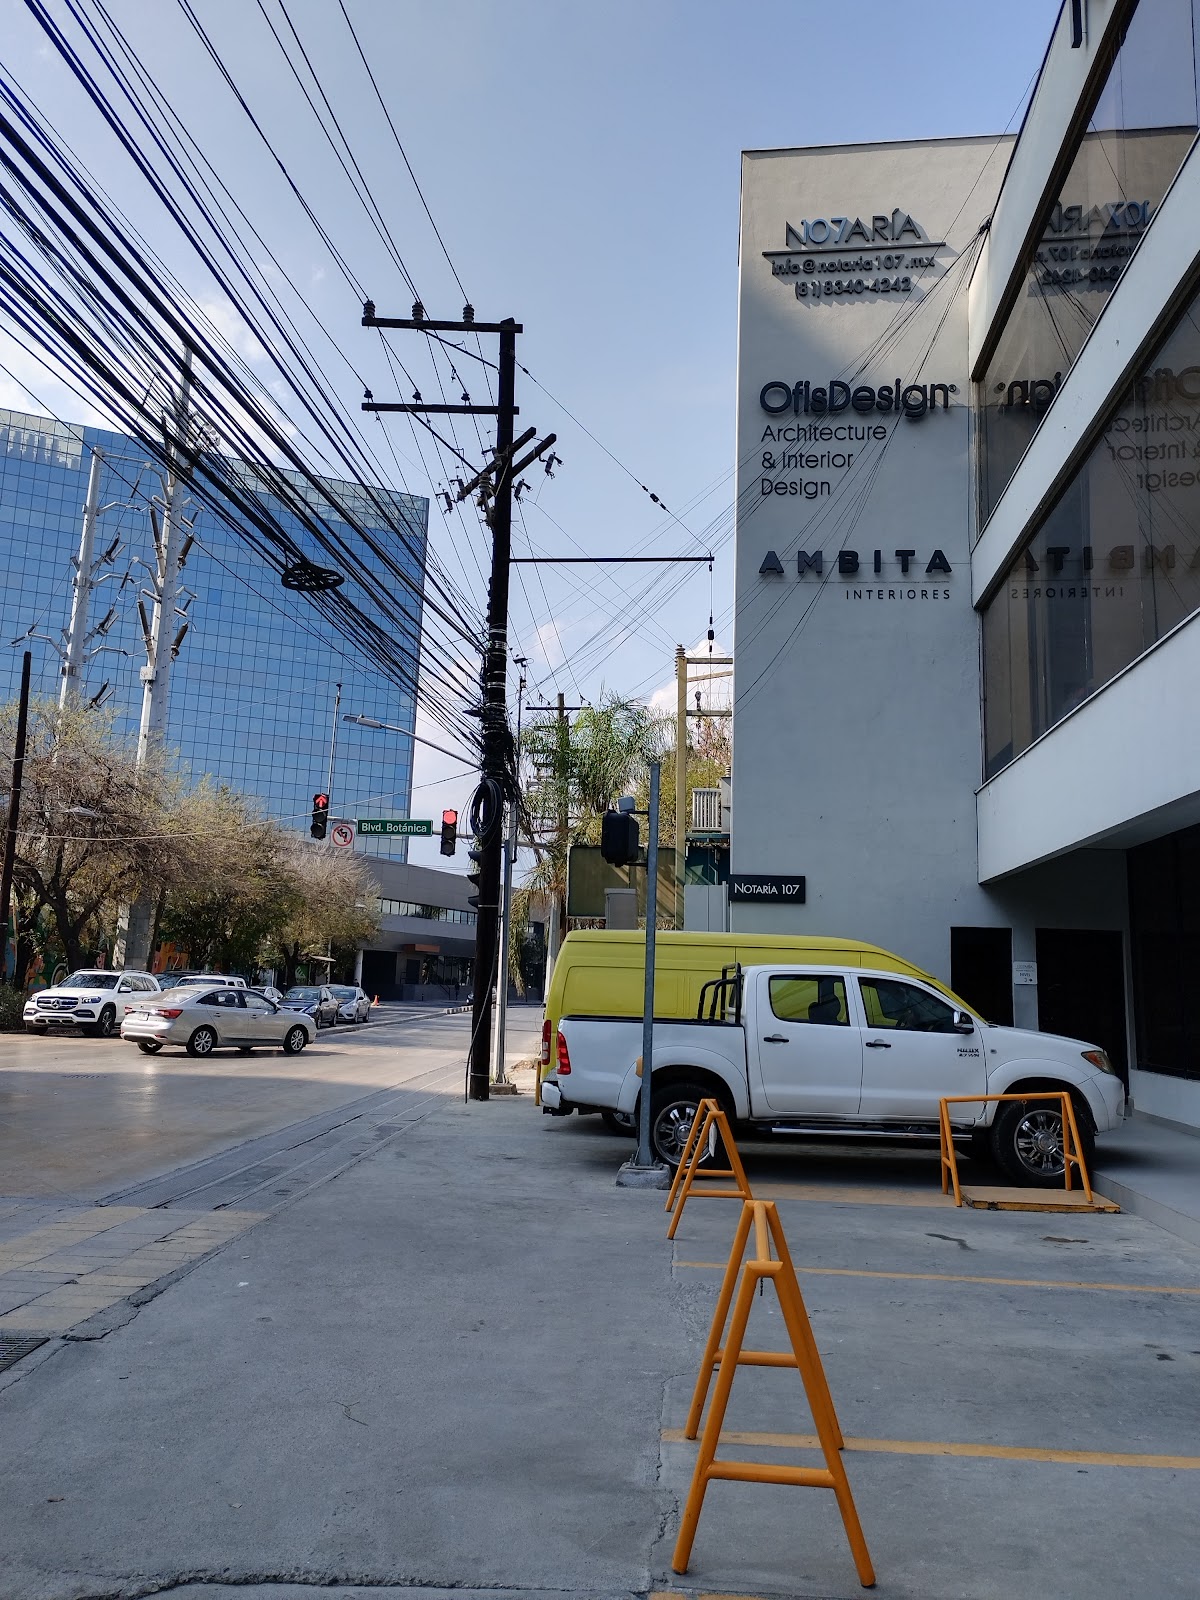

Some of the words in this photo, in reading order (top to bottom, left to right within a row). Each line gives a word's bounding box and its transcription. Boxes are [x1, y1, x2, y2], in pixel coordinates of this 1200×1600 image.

[771, 254, 936, 276] info@notaria107.mx
[760, 423, 887, 442] Architecture
[761, 451, 776, 469] &
[782, 450, 854, 469] Interior
[760, 478, 831, 500] Design
[758, 549, 952, 574] AMBITA
[846, 589, 951, 600] INTERIORES
[361, 822, 384, 832] Blvd.
[386, 822, 428, 833] Botánica
[734, 882, 778, 895] NOTARÍA
[781, 884, 800, 895] 107
